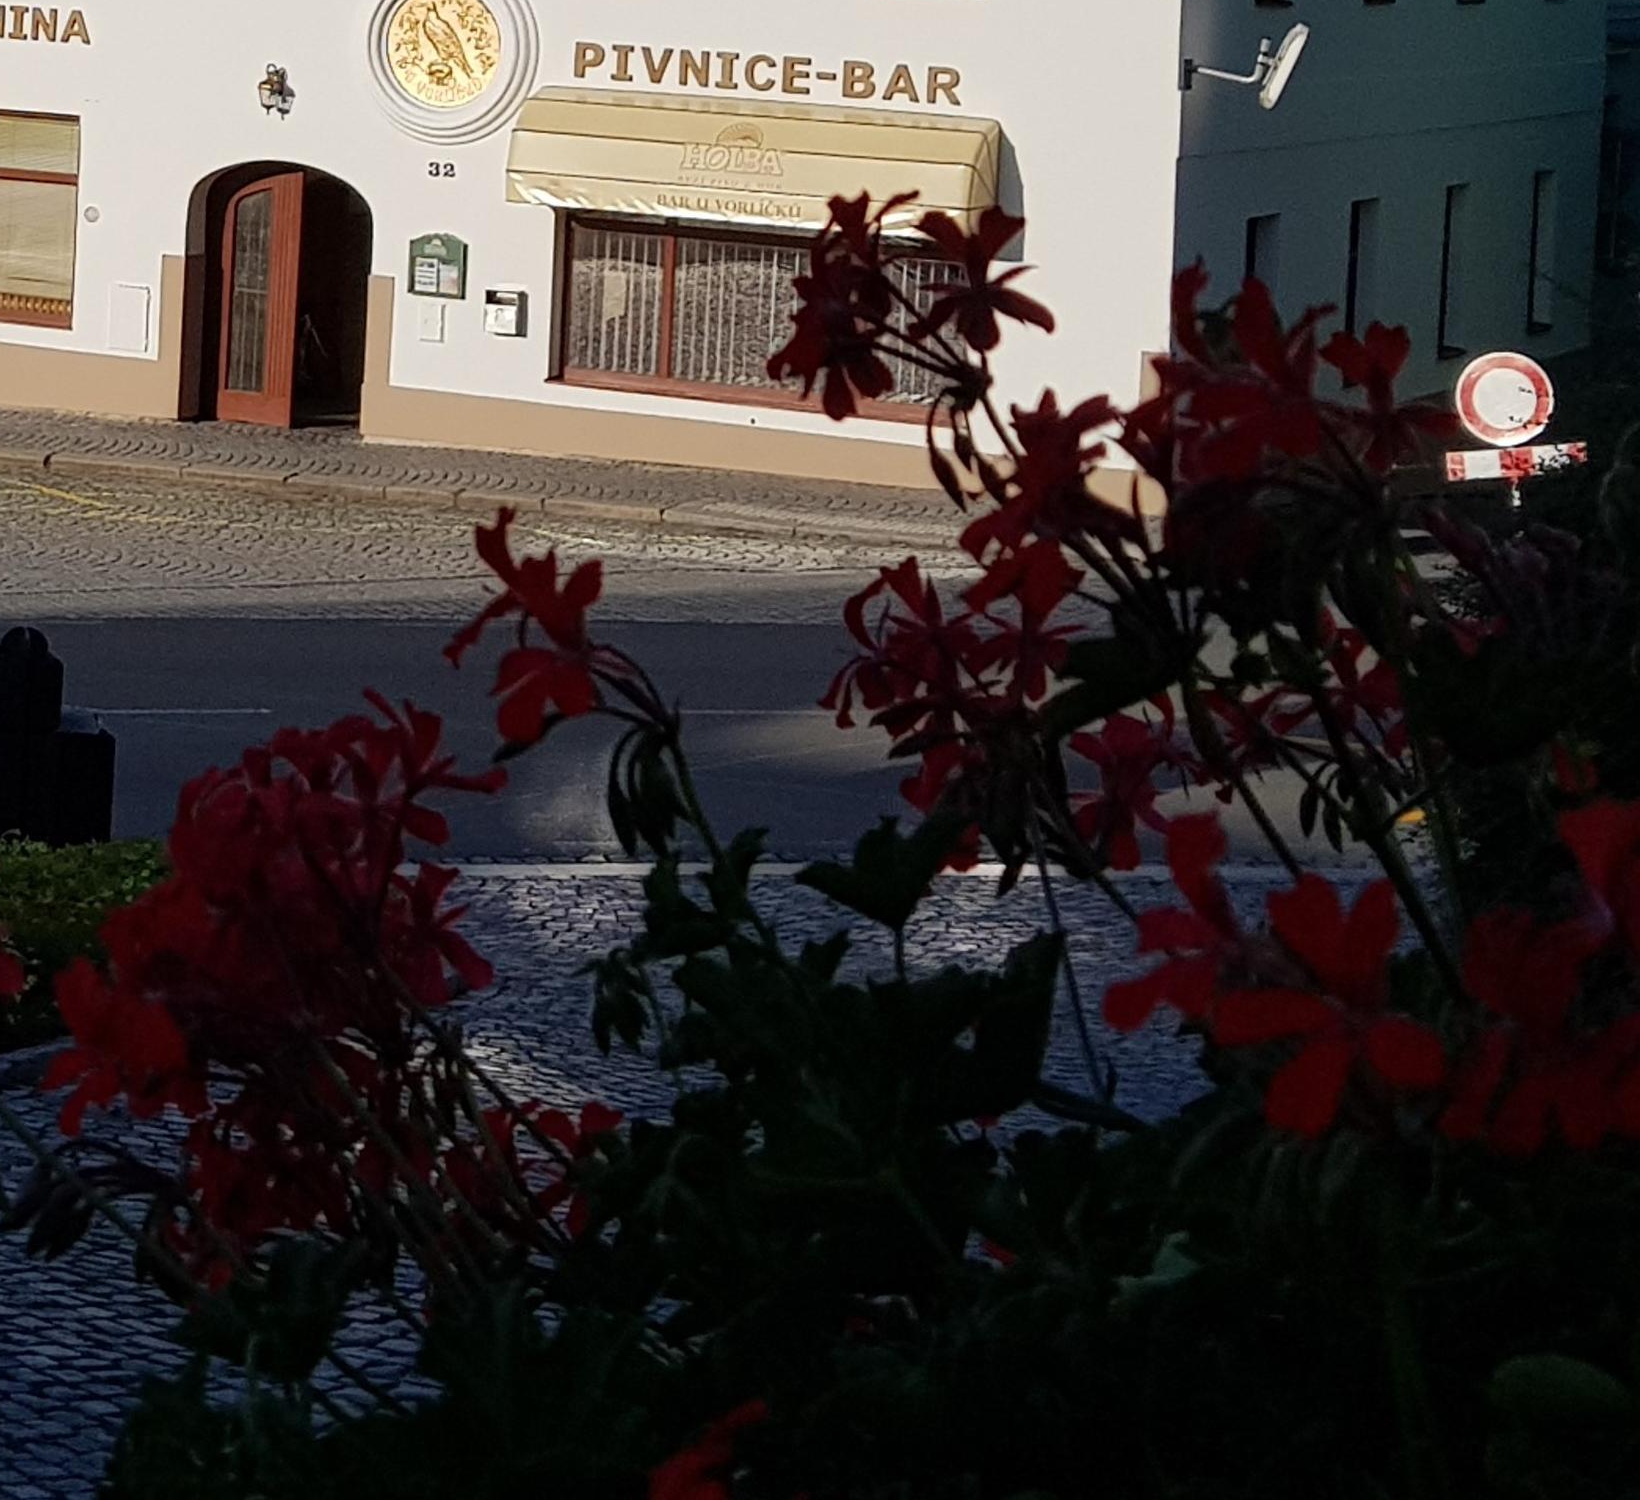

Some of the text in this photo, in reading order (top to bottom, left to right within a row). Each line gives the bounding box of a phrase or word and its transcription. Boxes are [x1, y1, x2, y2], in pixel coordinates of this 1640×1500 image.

[573, 41, 962, 106] PIVNICE-BAR
[427, 161, 457, 178] 32
[680, 142, 784, 177] HOLBA
[656, 193, 690, 209] BAR
[696, 198, 709, 210] U
